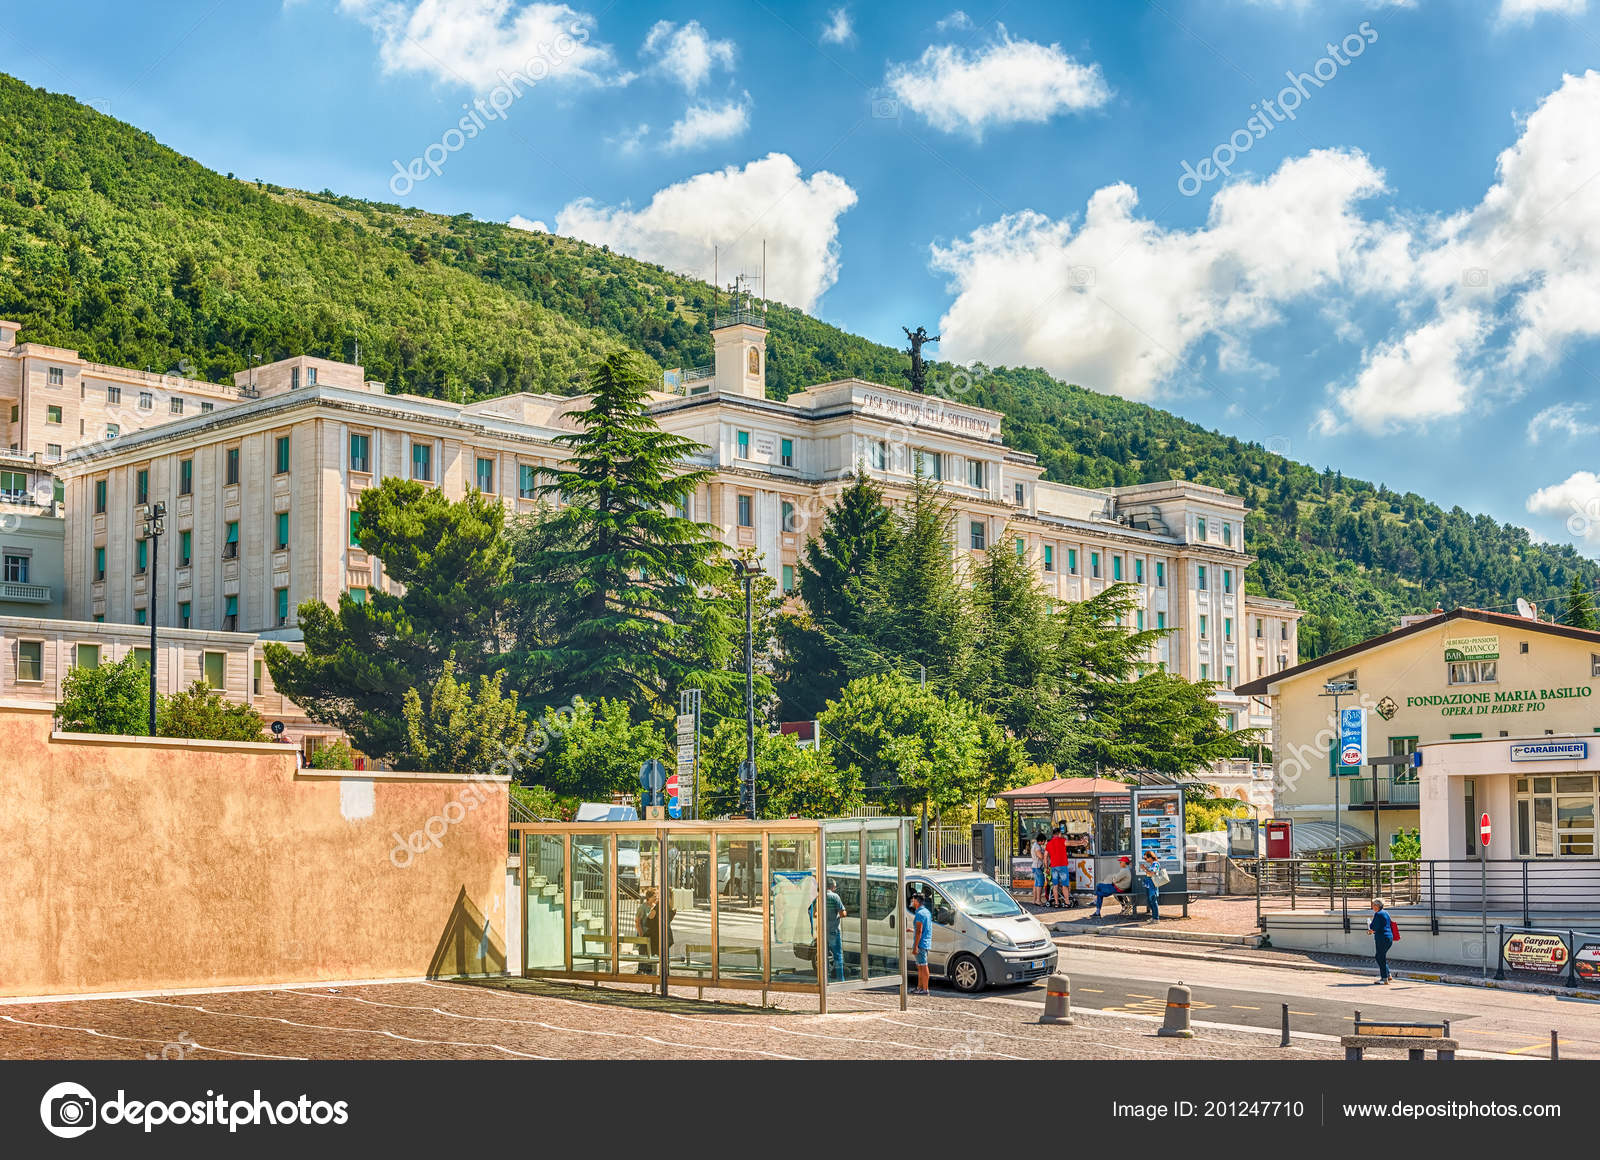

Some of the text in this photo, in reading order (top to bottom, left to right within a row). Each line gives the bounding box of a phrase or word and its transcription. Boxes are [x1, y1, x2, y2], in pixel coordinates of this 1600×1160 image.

[864, 394, 883, 409] CASA
[886, 398, 920, 417] SOLLIEVO
[1446, 652, 1462, 660] BAR
[1407, 686, 1592, 707] FONDAZIONE MARIA BASILIO
[1441, 702, 1545, 716] OPERA DI PADRE PIO
[1523, 744, 1584, 754] CARABINIERI
[1524, 936, 1559, 946] Gargano
[1524, 945, 1552, 953] Ricordi
